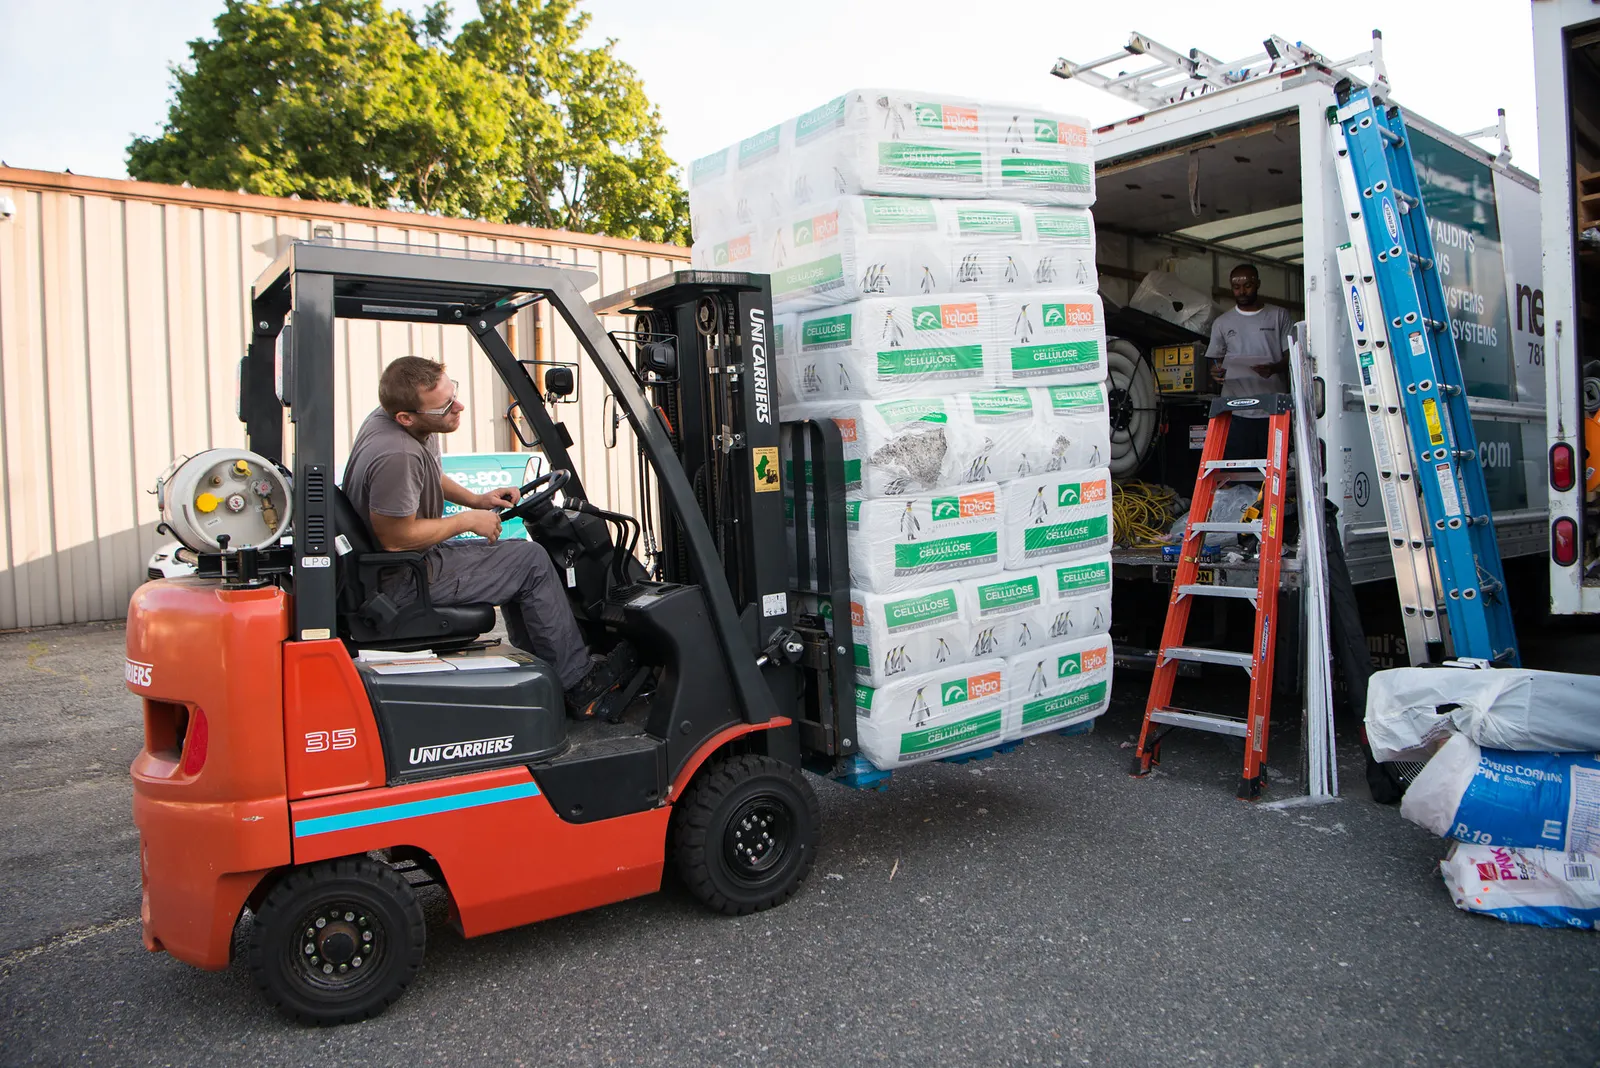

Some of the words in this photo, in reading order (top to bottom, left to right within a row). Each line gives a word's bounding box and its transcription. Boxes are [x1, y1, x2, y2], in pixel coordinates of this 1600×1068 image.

[1436, 221, 1475, 254] AUDITS
[787, 266, 824, 285] CELLULOSE
[1443, 284, 1484, 316] YSTEMS
[945, 309, 975, 328] igloo
[1067, 308, 1092, 327] igloo
[806, 323, 846, 337] CELLULOSE
[1451, 319, 1497, 347] SYSTEMS
[903, 354, 957, 367] CELLULOSE
[1033, 349, 1078, 361] CELLULOSE
[977, 394, 1026, 408] CELLULOSE
[1055, 390, 1097, 401] CELLULOSE
[1358, 480, 1369, 499] 31
[1046, 526, 1089, 540] CELLULOSE
[919, 543, 972, 559] CELLULOSE
[303, 557, 330, 567] LPG
[1063, 569, 1106, 583] CELLULOSE
[985, 584, 1034, 601] CELLULOSE
[893, 597, 950, 619] CELLULOSE
[971, 680, 999, 698] igloo
[1045, 692, 1090, 712] CELLULOSE
[305, 728, 357, 753] 35
[927, 722, 978, 743] CELLULOSE
